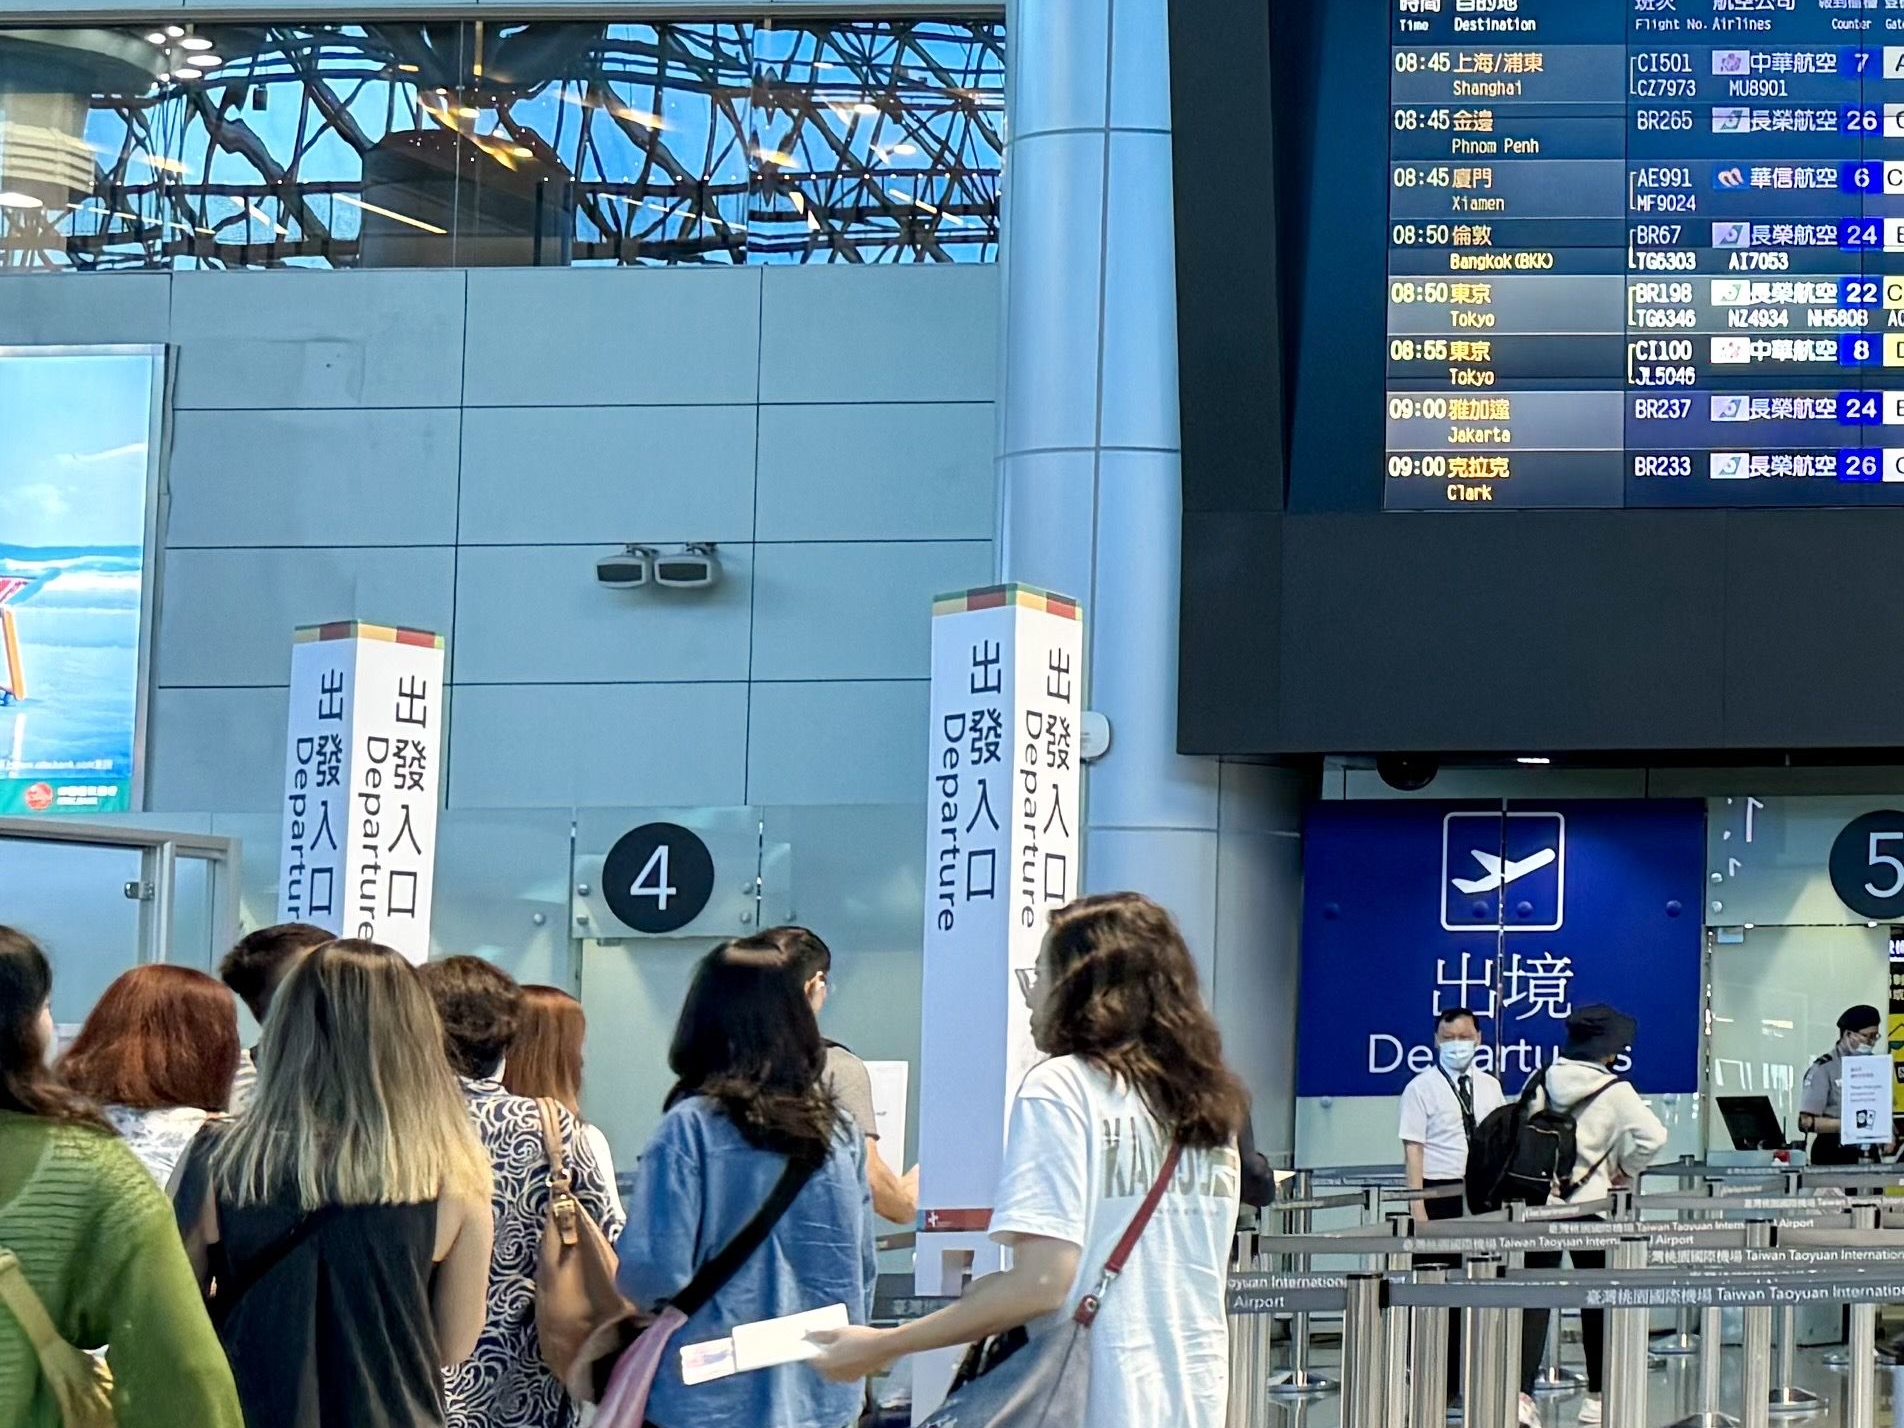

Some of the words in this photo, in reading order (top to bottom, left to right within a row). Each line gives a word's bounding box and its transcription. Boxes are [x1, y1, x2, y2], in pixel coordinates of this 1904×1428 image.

[1454, 17, 1535, 31] Destination
[1396, 53, 1450, 72] 08:45
[1638, 53, 1692, 72] CI501
[1395, 110, 1449, 130] 08:45
[1638, 110, 1692, 130] BR265
[1394, 168, 1449, 186] 08:45
[1638, 168, 1692, 187] AE991
[1452, 196, 1504, 210] Xiamen
[1393, 225, 1448, 244] 08:50
[1637, 225, 1681, 244] BR67
[1392, 283, 1448, 303] 08:50
[1450, 283, 1491, 304] 東京
[1635, 283, 1692, 303] BR198
[1451, 311, 1494, 327] Tokyo
[1391, 340, 1447, 360] 08:55
[1635, 340, 1692, 360] CI100
[1390, 398, 1446, 419] 09:00
[1636, 399, 1691, 418] BR237
[1448, 427, 1510, 442] Jakarta
[1389, 456, 1445, 476] 09:00
[1635, 457, 1690, 476] BR233
[1448, 485, 1491, 500] Clark
[965, 639, 1001, 900] 出發入口
[1043, 647, 1070, 904] 出發入口
[308, 668, 344, 916] 出發入口
[388, 675, 428, 917] 出發入口
[288, 737, 315, 920] Departur
[937, 713, 966, 932] Departure
[1021, 710, 1041, 929] Departure
[1865, 832, 1904, 897] 5
[630, 845, 676, 909] 4
[1433, 952, 1573, 1020] 出境
[1369, 1034, 1632, 1072] Deartus
[1746, 1249, 1786, 1261] Taiwan
[1789, 1249, 1838, 1263] Taoyuan
[1234, 1295, 1285, 1310] Airport
[1717, 1288, 1765, 1302] Taiwan
[1770, 1287, 1829, 1304] Taoyuan
